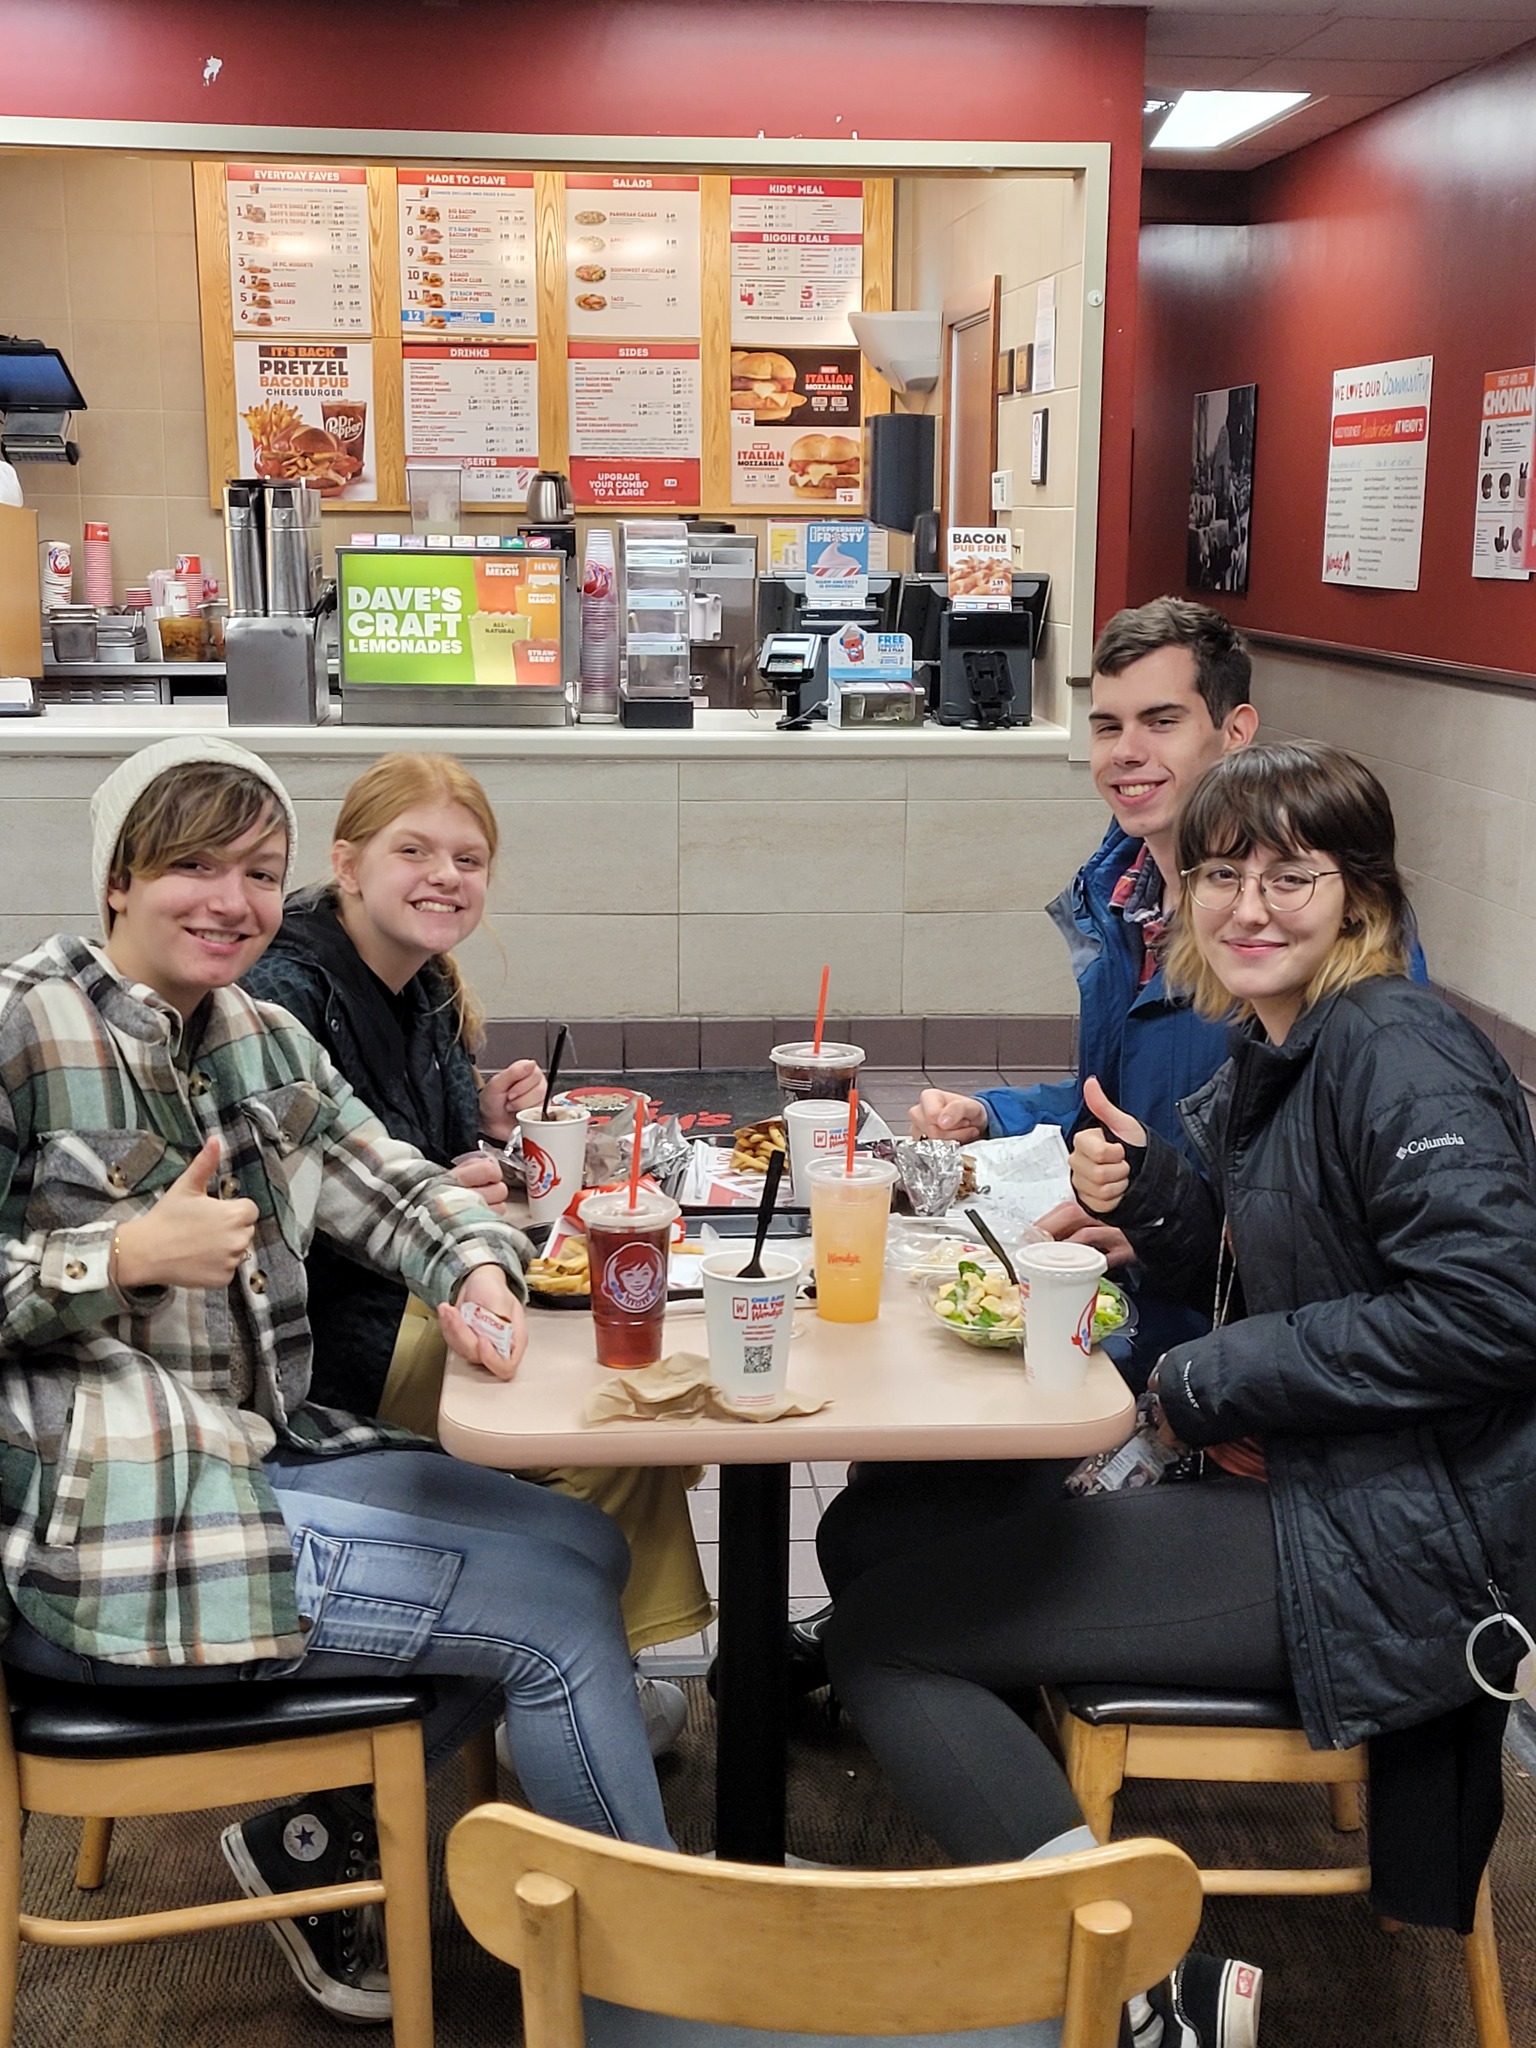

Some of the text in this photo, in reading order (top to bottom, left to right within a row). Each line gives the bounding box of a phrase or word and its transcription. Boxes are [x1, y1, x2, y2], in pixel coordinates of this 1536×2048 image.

[254, 170, 340, 181] EVERYDAY FAVES
[426, 175, 506, 185] MADE TO CRAVE
[613, 179, 652, 188] SALADS
[769, 185, 824, 194] KIDS' MEAL
[237, 207, 242, 216] 1
[406, 206, 412, 215] 7
[407, 226, 413, 235] 8
[238, 231, 243, 240] 2
[763, 234, 829, 243] BIGGIE DEALS
[407, 247, 414, 256] 9
[239, 257, 245, 266] 3
[239, 275, 246, 284] 4
[408, 271, 419, 280] 10
[240, 292, 246, 301] 5
[408, 291, 418, 300] 11
[241, 310, 247, 319] 6
[407, 311, 420, 320] 12
[271, 347, 335, 357] IT'S BACK
[450, 349, 490, 357] DRINKS
[619, 349, 648, 357] SIDES
[259, 360, 348, 375] PRETZEL
[260, 376, 348, 388] BACON PUB
[805, 374, 853, 384] ITALIAN
[1366, 380, 1380, 397] OUR
[737, 451, 784, 460] ITALIAN
[953, 534, 1006, 544] BACON
[534, 563, 558, 571] NEW
[485, 568, 519, 576] MELON
[348, 587, 462, 611] DAVE'S
[348, 612, 461, 638] CRAFT
[349, 639, 463, 654] LEMONADES
[1408, 1133, 1465, 1154] Columbia
[827, 1252, 861, 1266] Wendy's
